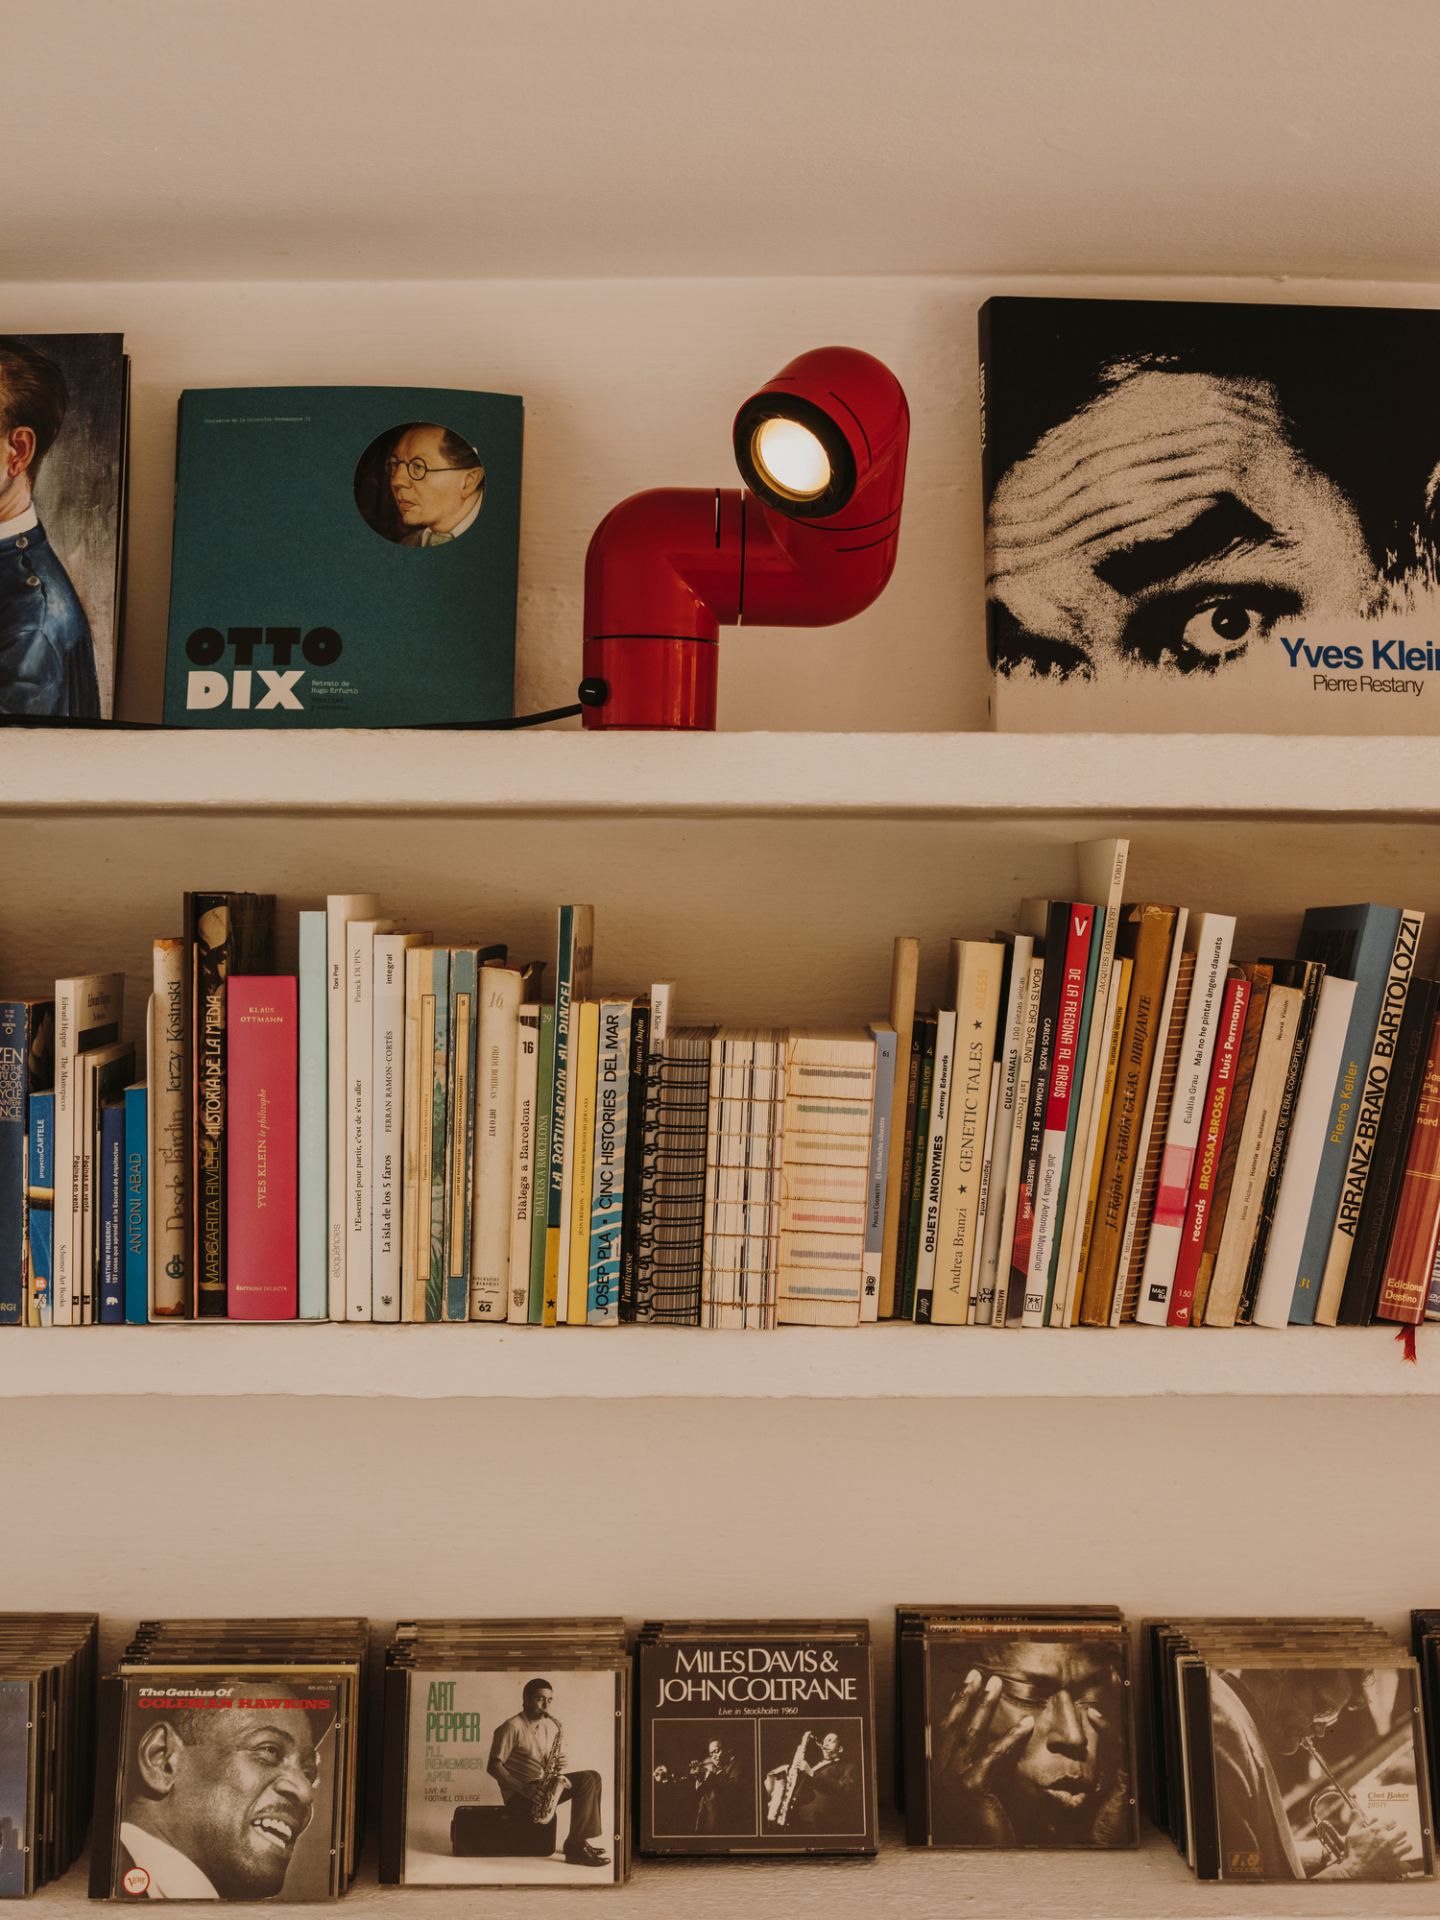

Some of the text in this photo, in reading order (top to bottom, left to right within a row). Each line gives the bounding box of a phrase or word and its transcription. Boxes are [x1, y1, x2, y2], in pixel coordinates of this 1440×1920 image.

[185, 626, 343, 667] OTTO
[1281, 637, 1363, 671] Yves
[186, 669, 307, 711] DIX
[1313, 674, 1424, 697] Pierre Restany
[354, 948, 362, 977] DUPIN
[384, 952, 394, 985] integral
[1097, 905, 1117, 995] JACQUES LOUIS NYST
[1193, 936, 1224, 1067] Mai no he pintat daurats
[1374, 916, 1421, 1059] BARTOLOZZI
[240, 1015, 285, 1024] OTTMANN
[248, 1006, 276, 1014] KLAUS
[1129, 994, 1152, 1066] DIBUJANTE
[165, 980, 185, 1094] Jerzy Kosinski
[521, 1041, 535, 1054] 16
[633, 1019, 645, 1076] Jacques Dupin
[1012, 1026, 1020, 1041] 100
[1015, 968, 1042, 1130] BOATS FOR SAILING Ian Proctor
[1053, 968, 1082, 1099] DE LA FREGONA AL AIRBUS
[1109, 1006, 1124, 1066] RICHARD WENTWORTH
[1217, 983, 1246, 1080] Lluís Permanyer
[205, 995, 221, 1135] HISTORIA DE LA MEDIA
[489, 1045, 499, 1100] ORIOL BOHIGAS
[551, 980, 570, 1190] LA ROTULACIÓN AL PINCEL
[1003, 1048, 1019, 1110] CUCA CANALS
[1187, 1073, 1200, 1094] Grau
[1278, 1115, 1289, 1129] DE
[1286, 1037, 1305, 1092] CONCEPTUAL
[384, 1100, 393, 1134] FERRAN
[598, 1014, 619, 1210] CINC HISTORIES DEL MAR
[1021, 1017, 1052, 1219] CARLOS PAZOS FROMAGE DE TÊTE 1998
[1329, 1060, 1359, 1144] Pierre Keller
[1416, 1116, 1439, 1127] nord
[58, 997, 69, 1308] Edward Hopper The Masterpieces Art Books
[112, 1141, 121, 1178] Arquitectura
[257, 1088, 271, 1209] YVES KLEIN philosophe
[354, 1079, 364, 1232] L'Essentiel pour de aller
[516, 1099, 530, 1221] Diàlegs a Barcelona
[536, 1113, 549, 1169] BARCELONA
[924, 1054, 949, 1253] OBJETS ANONYMES Jeremy Edwards
[382, 1154, 392, 1181] faros
[948, 1041, 984, 1294] Andrea Branzi GENETIC TALES
[112, 1186, 120, 1208] Escuela
[128, 1152, 143, 1254] ANTONI ABAD
[165, 1174, 184, 1232] Desde
[382, 1190, 391, 1206] los
[382, 1208, 391, 1221] de
[382, 1222, 391, 1240] isla
[1034, 1168, 1055, 1272] Capella Antonio Monturiol
[1190, 1198, 1207, 1242] records
[205, 1200, 219, 1284] MARGARITA
[382, 1241, 391, 1253] La
[112, 1273, 120, 1284] 101
[595, 1231, 611, 1315] JOSEP PLA
[621, 1252, 633, 1303] l'anticasse
[1387, 1278, 1424, 1292] Edicions
[1385, 1289, 1417, 1303] Destino
[674, 1647, 840, 1673] MILES DAVIS &
[138, 1687, 236, 1699] The Genius Of
[138, 1697, 331, 1710] COLEMAN HAWKINS
[426, 1681, 457, 1712] ART
[655, 1675, 859, 1708] JOHN COLTRANE
[718, 1706, 799, 1716] Live in Stockholm 1960
[425, 1712, 481, 1743] PEPPER
[425, 1758, 483, 1770] REMEMBER
[425, 1770, 455, 1783] APRIL
[424, 1787, 440, 1795] LIVE
[424, 1794, 481, 1802] FOOTHILL COLLEGE
[1386, 1791, 1409, 1800] Baker
